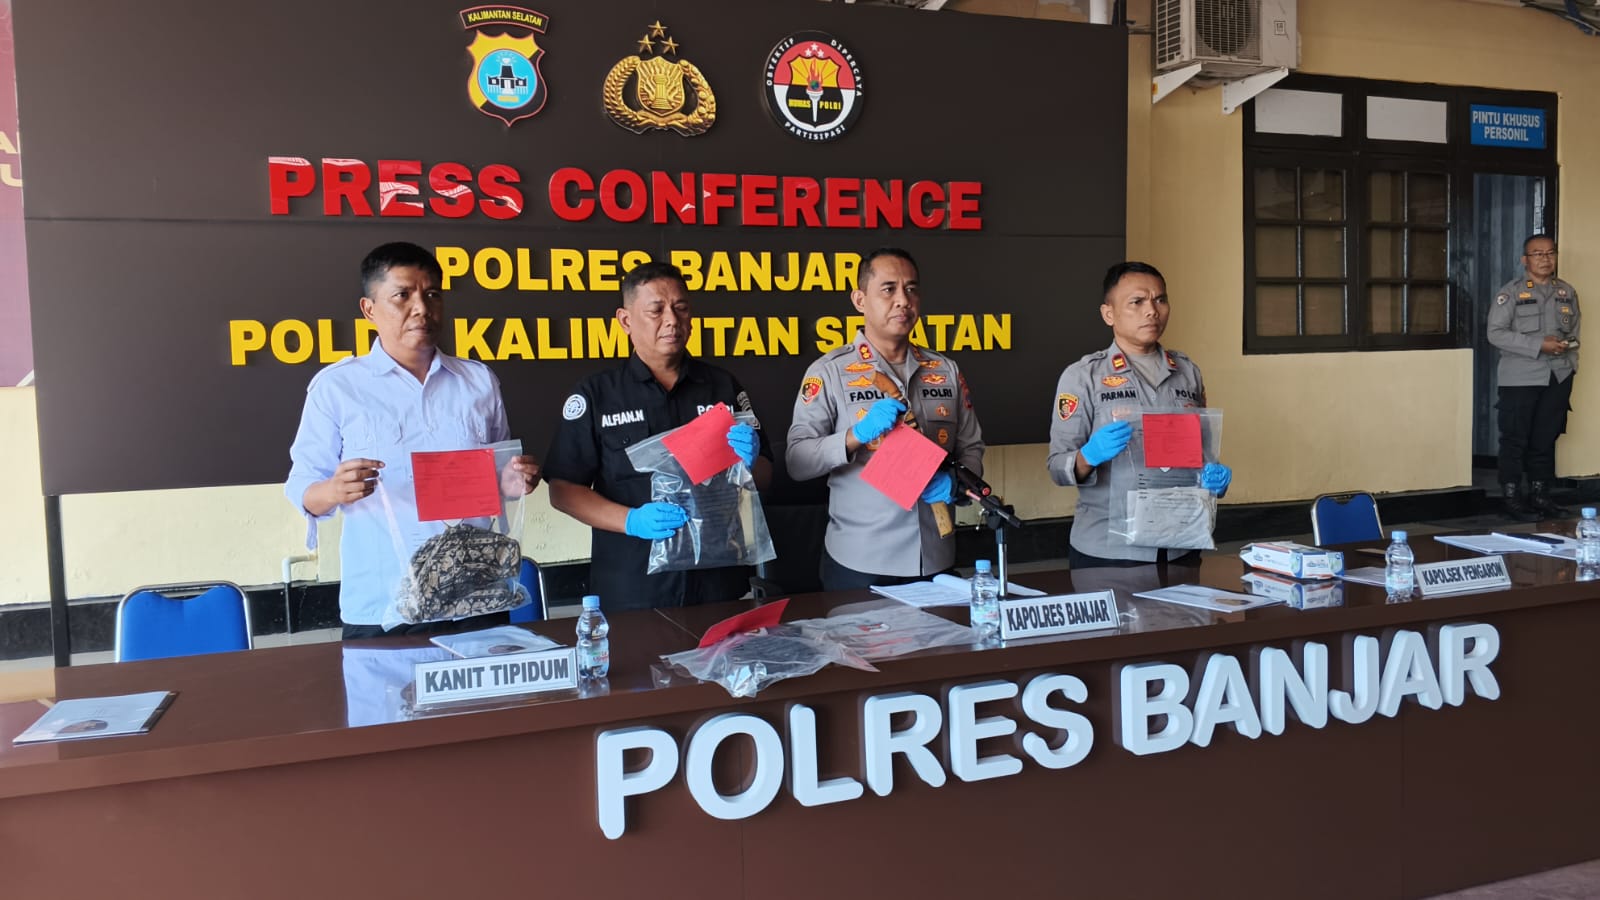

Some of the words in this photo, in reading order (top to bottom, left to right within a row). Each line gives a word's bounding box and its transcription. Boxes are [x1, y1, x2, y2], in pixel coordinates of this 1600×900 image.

[467, 10, 511, 22] KALIMANTAN
[511, 11, 543, 27] SELATAN
[766, 38, 795, 86] OBYEKTIF
[830, 39, 863, 97] DIPERCAYA
[784, 121, 846, 140] PARTISIPASI
[1472, 110, 1501, 125] PINTU
[1502, 112, 1541, 128] KHUSUS
[1483, 126, 1529, 142] PERSONIL
[268, 156, 524, 220] PRESS
[547, 167, 982, 230] CONFERENCE
[670, 250, 861, 292] BANJAR
[229, 317, 378, 366] POLD
[454, 316, 799, 361] KALIMNTAN
[815, 313, 1012, 356] SEATAN
[922, 388, 953, 399] POLRI
[1101, 389, 1137, 402] PARMAN
[601, 409, 645, 428] ALFIAN.N
[1422, 566, 1464, 586] KAPOLSEK
[1462, 561, 1505, 581] PENGARON
[1006, 603, 1066, 632] KAPOLRES
[1065, 599, 1111, 625] BANJAR
[425, 666, 485, 693] KANIT
[490, 658, 569, 686] TIPIDUM
[595, 672, 1094, 840] POLRES
[1119, 622, 1500, 755] BANJAR
